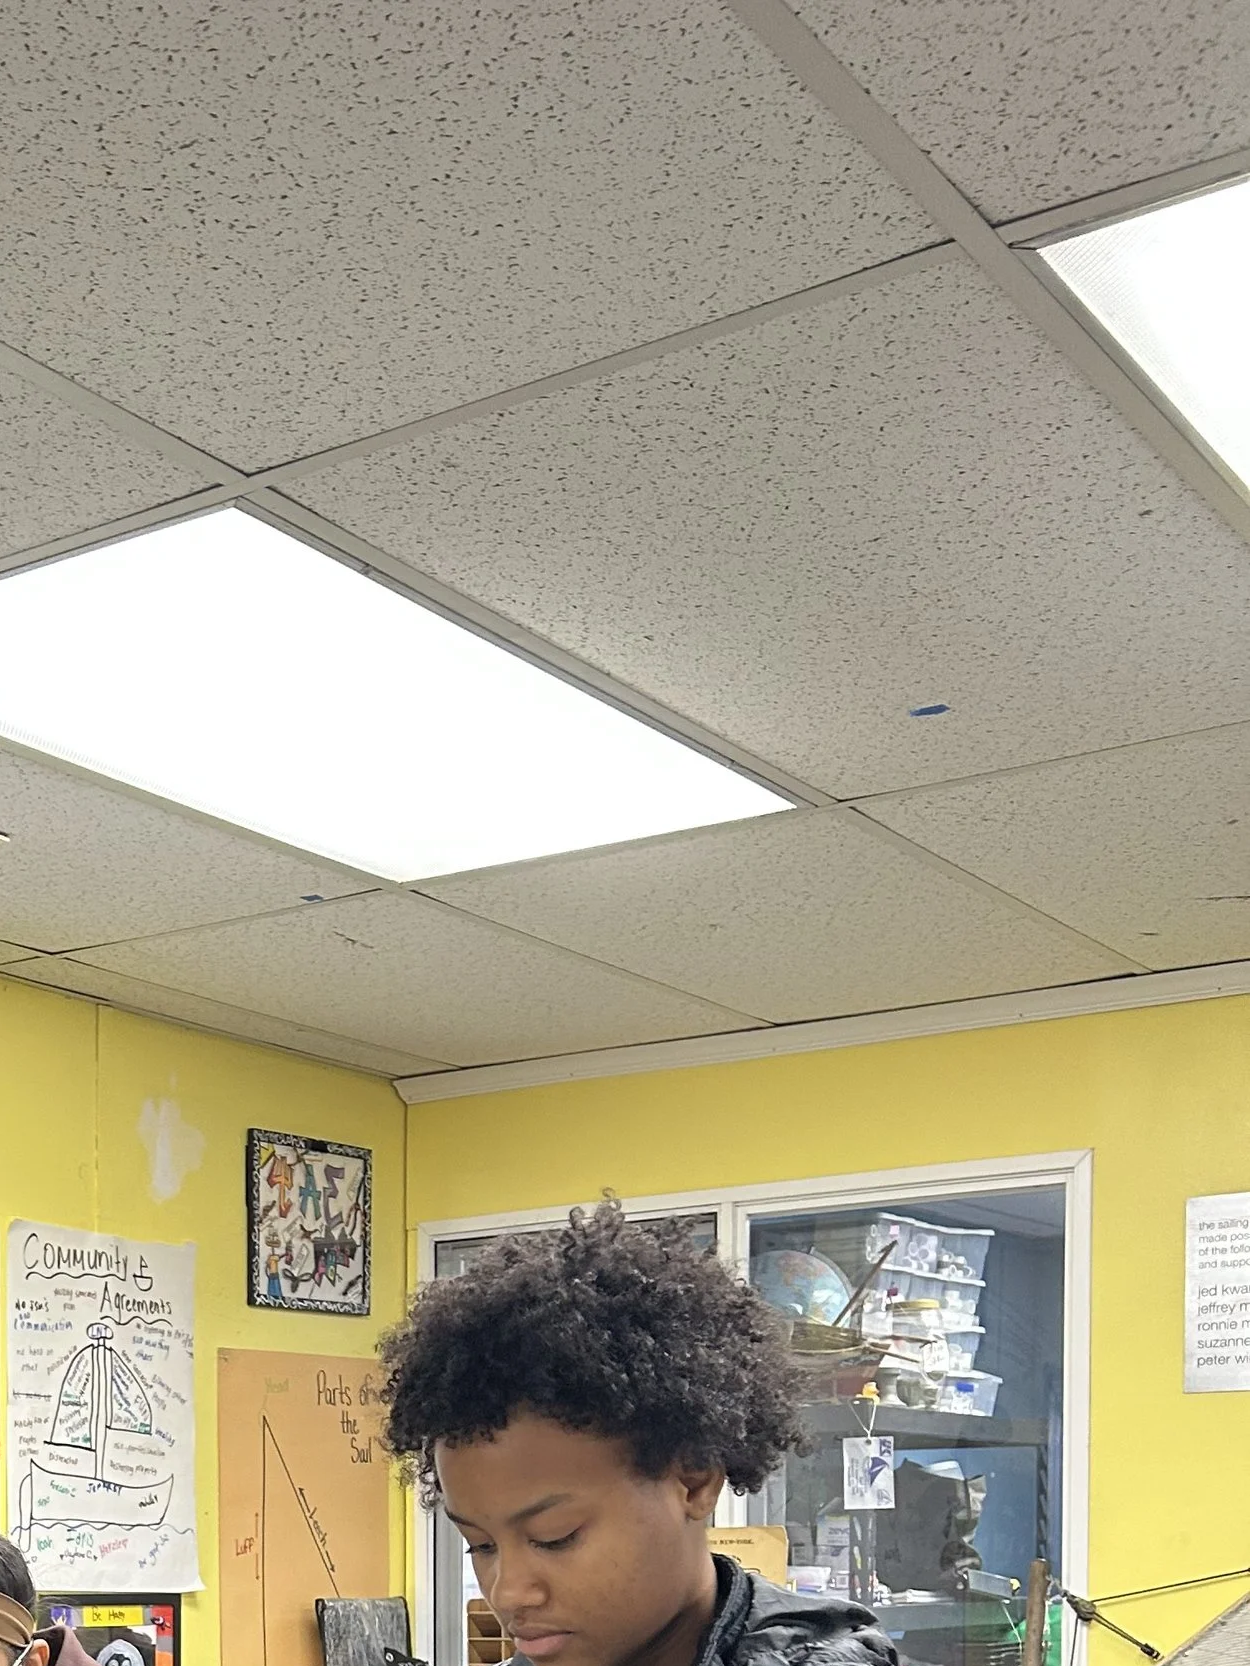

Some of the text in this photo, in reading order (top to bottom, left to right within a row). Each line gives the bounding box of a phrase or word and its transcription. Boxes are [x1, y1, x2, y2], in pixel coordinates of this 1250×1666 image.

[1199, 1219, 1249, 1230] the sailing
[1199, 1234, 1227, 1243] made
[23, 1233, 128, 1281] Community
[1199, 1247, 1209, 1256] of
[1212, 1246, 1227, 1255] the
[1199, 1260, 1217, 1269] and
[1198, 1284, 1250, 1299] jed kwa
[100, 1281, 173, 1325] Agreements
[1198, 1301, 1236, 1316] jeffrey
[1197, 1318, 1238, 1331] ronnie
[1197, 1354, 1230, 1368] peter
[316, 1369, 352, 1406] Parts
[340, 1410, 360, 1434] the
[351, 1437, 372, 1463] Sail
[235, 1537, 255, 1557] Luff
